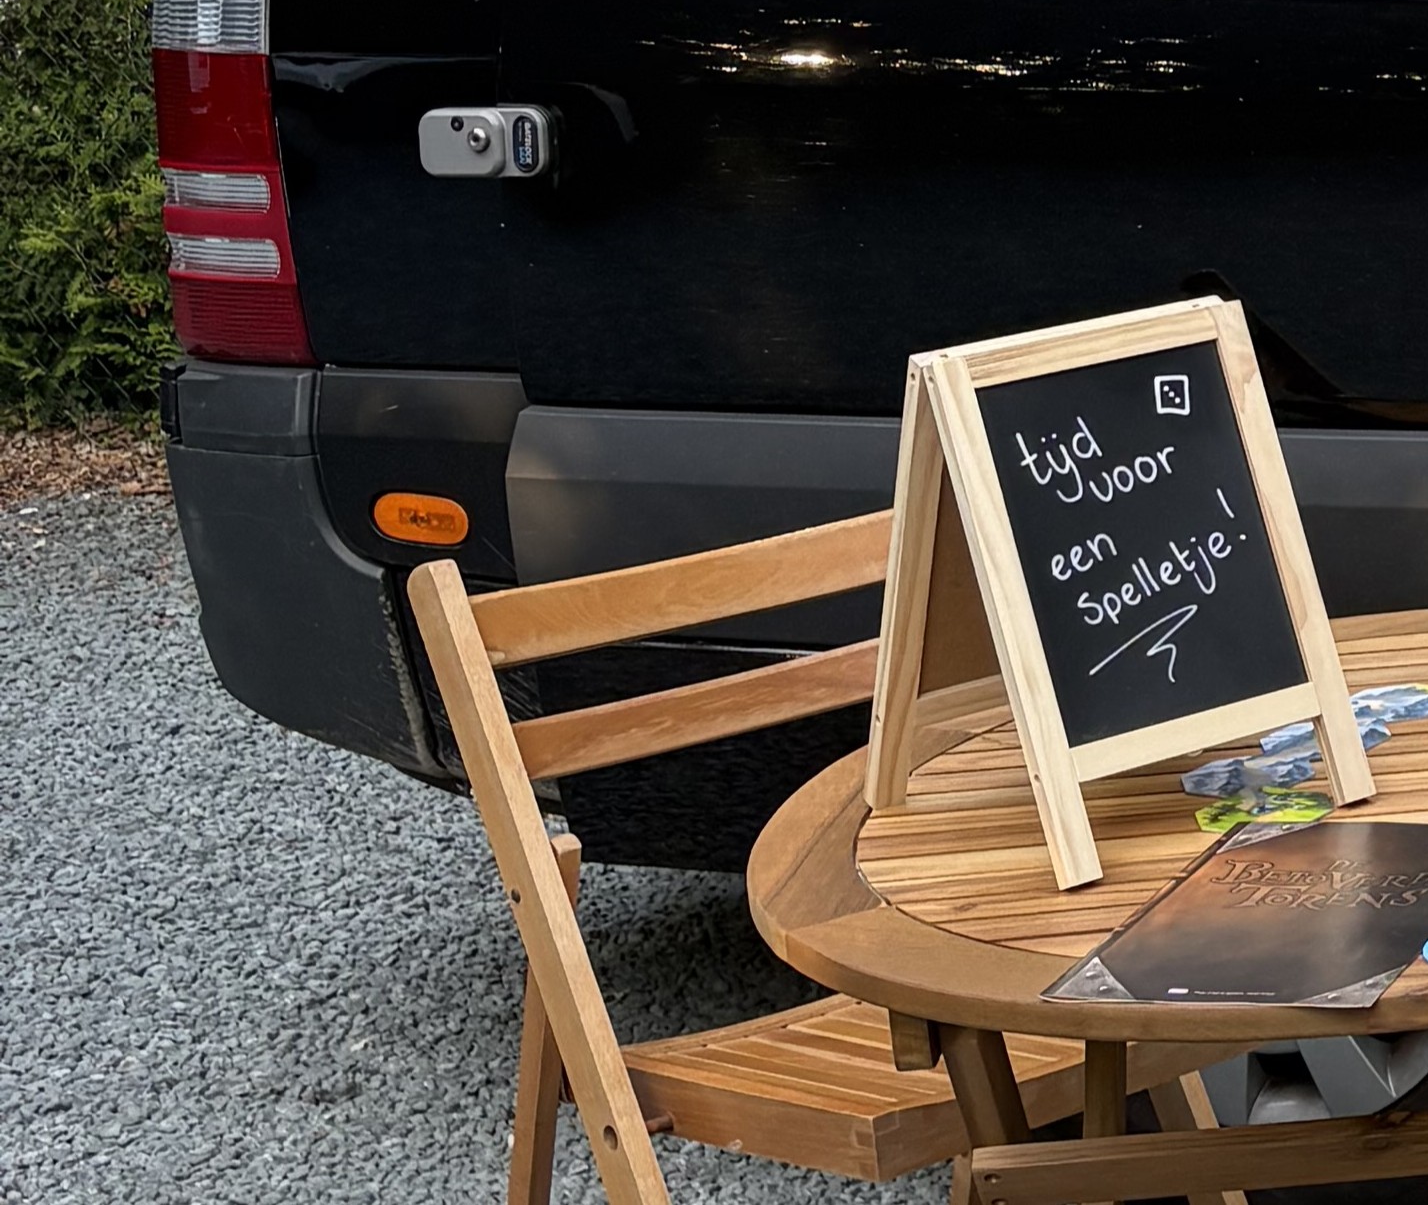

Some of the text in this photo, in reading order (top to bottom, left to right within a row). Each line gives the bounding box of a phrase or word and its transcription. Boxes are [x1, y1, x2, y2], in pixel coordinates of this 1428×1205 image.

[1015, 416, 1103, 503] tijd
[1089, 446, 1176, 502] voor
[1050, 532, 1118, 581] een
